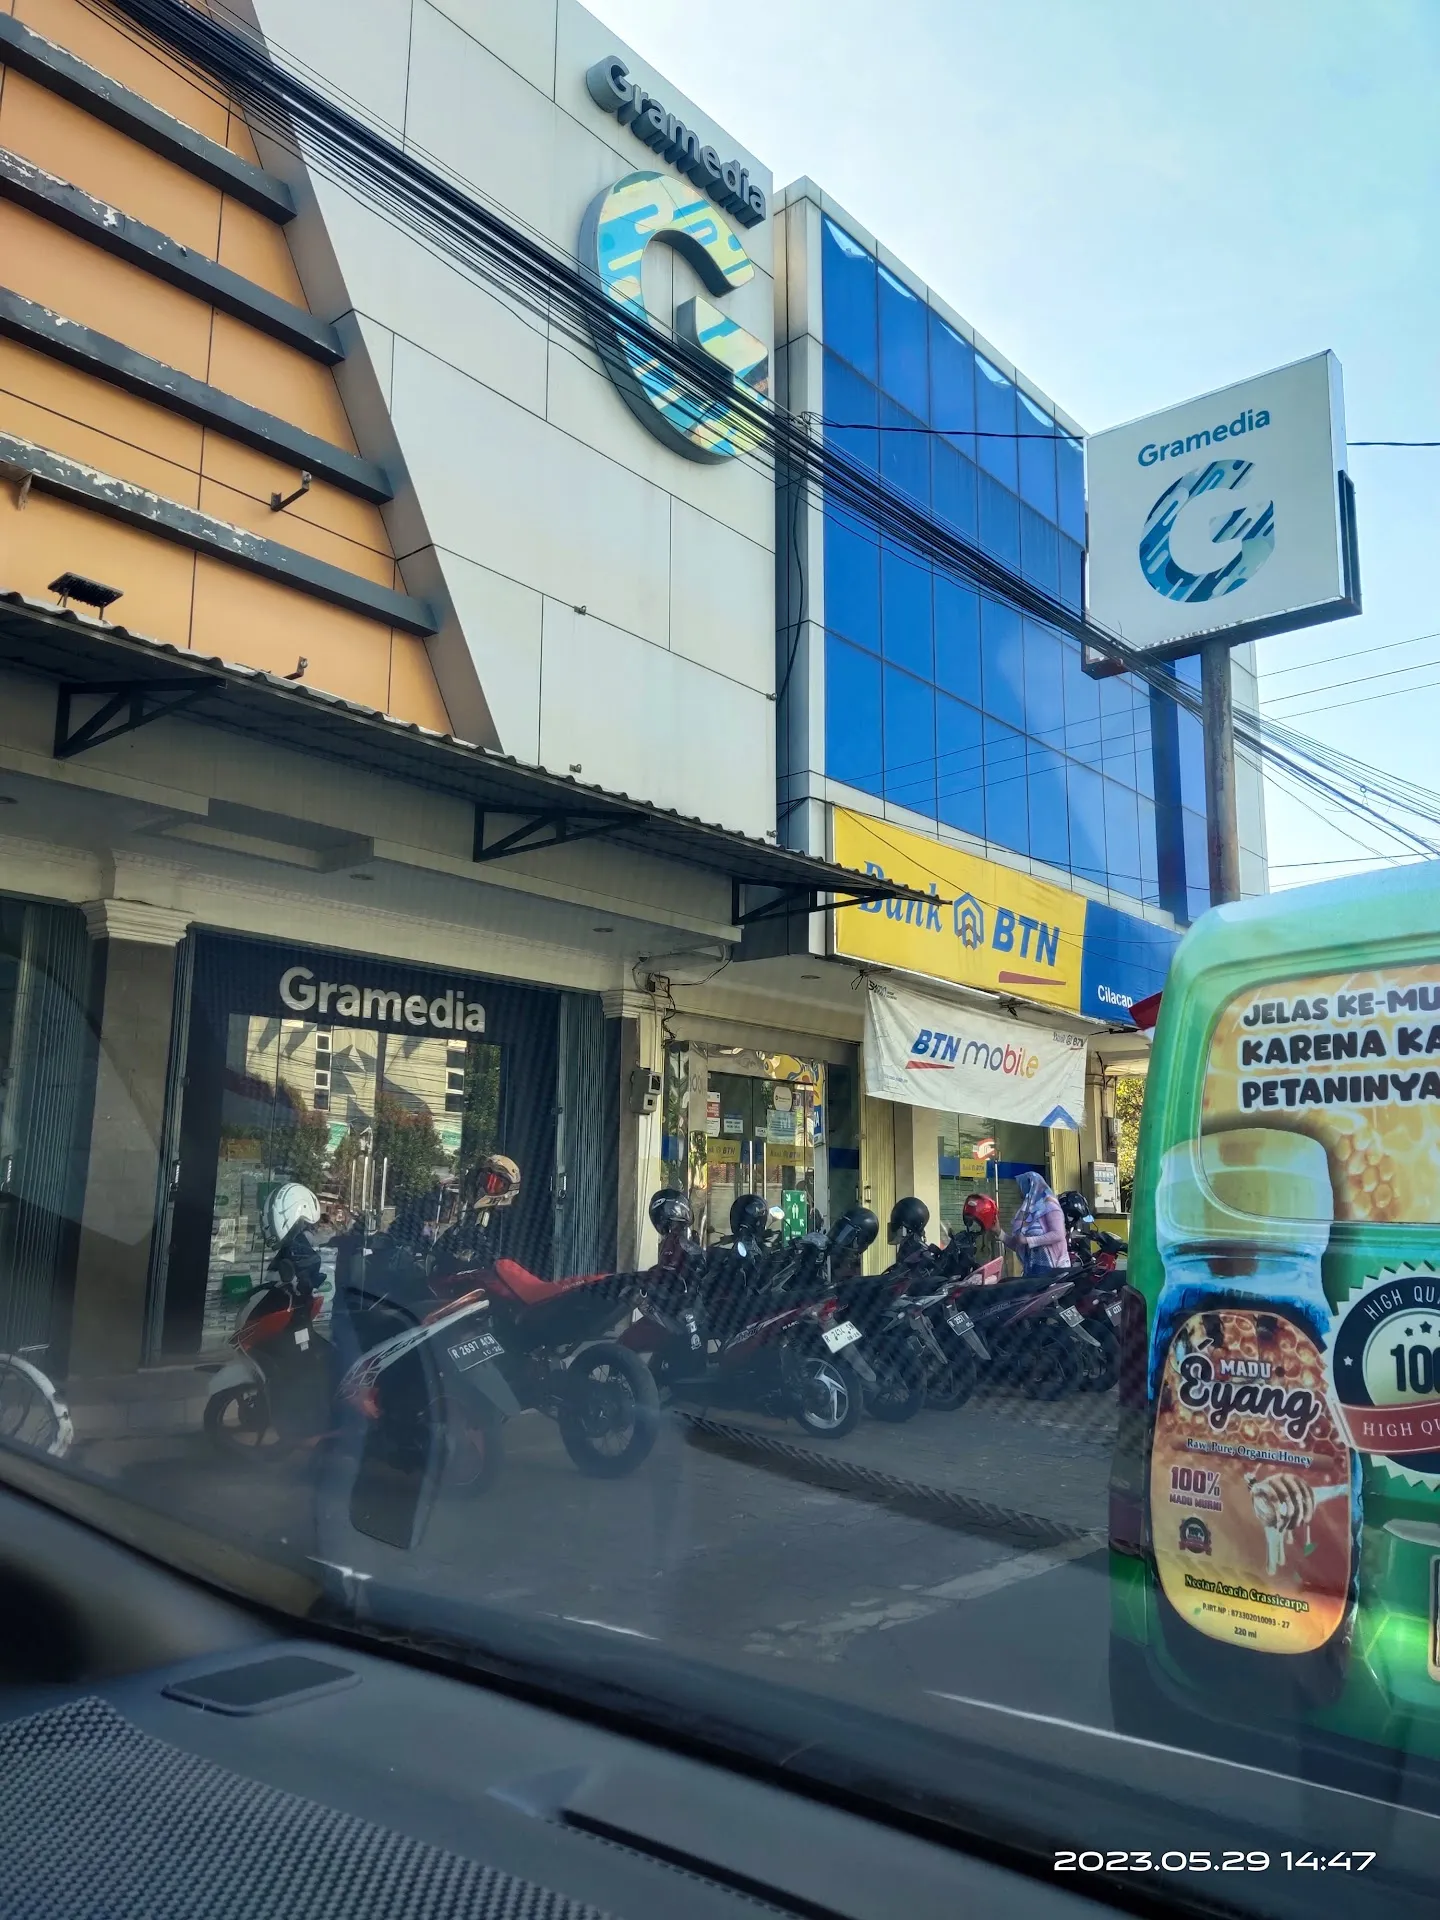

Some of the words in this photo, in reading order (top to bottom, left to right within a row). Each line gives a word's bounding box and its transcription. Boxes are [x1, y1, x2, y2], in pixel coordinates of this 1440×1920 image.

[587, 55, 767, 229] Gramedia
[1137, 408, 1270, 467] Gramedia
[992, 907, 1060, 967] BTN
[279, 966, 486, 1033] Gramedia
[1097, 984, 1133, 1008] Cilacap
[1243, 998, 1329, 1027] JELAS
[911, 1028, 962, 1063] BTN
[962, 1041, 1039, 1079] mobile
[1242, 1030, 1387, 1066] KARENA
[1242, 1071, 1440, 1109] PETANINYA
[1364, 1288, 1403, 1321] HIGH
[1413, 1286, 1440, 1306] QU
[451, 1349, 460, 1359] R
[459, 1341, 480, 1356] 2697
[1220, 1359, 1272, 1379] MADU
[1363, 1422, 1413, 1437] HIGH
[1211, 1441, 1235, 1456] Pure,
[1237, 1445, 1277, 1460] Organic
[1279, 1451, 1313, 1468] Honey
[1171, 1466, 1220, 1497] 100%
[1170, 1494, 1193, 1507] MADU
[1194, 1499, 1222, 1512] MURNI
[1185, 1575, 1215, 1592] Nectar
[1217, 1582, 1248, 1599] Acacia
[1249, 1590, 1309, 1612] Crassicarpa
[1234, 1626, 1247, 1637] 220
[1248, 1630, 1257, 1639] ml
